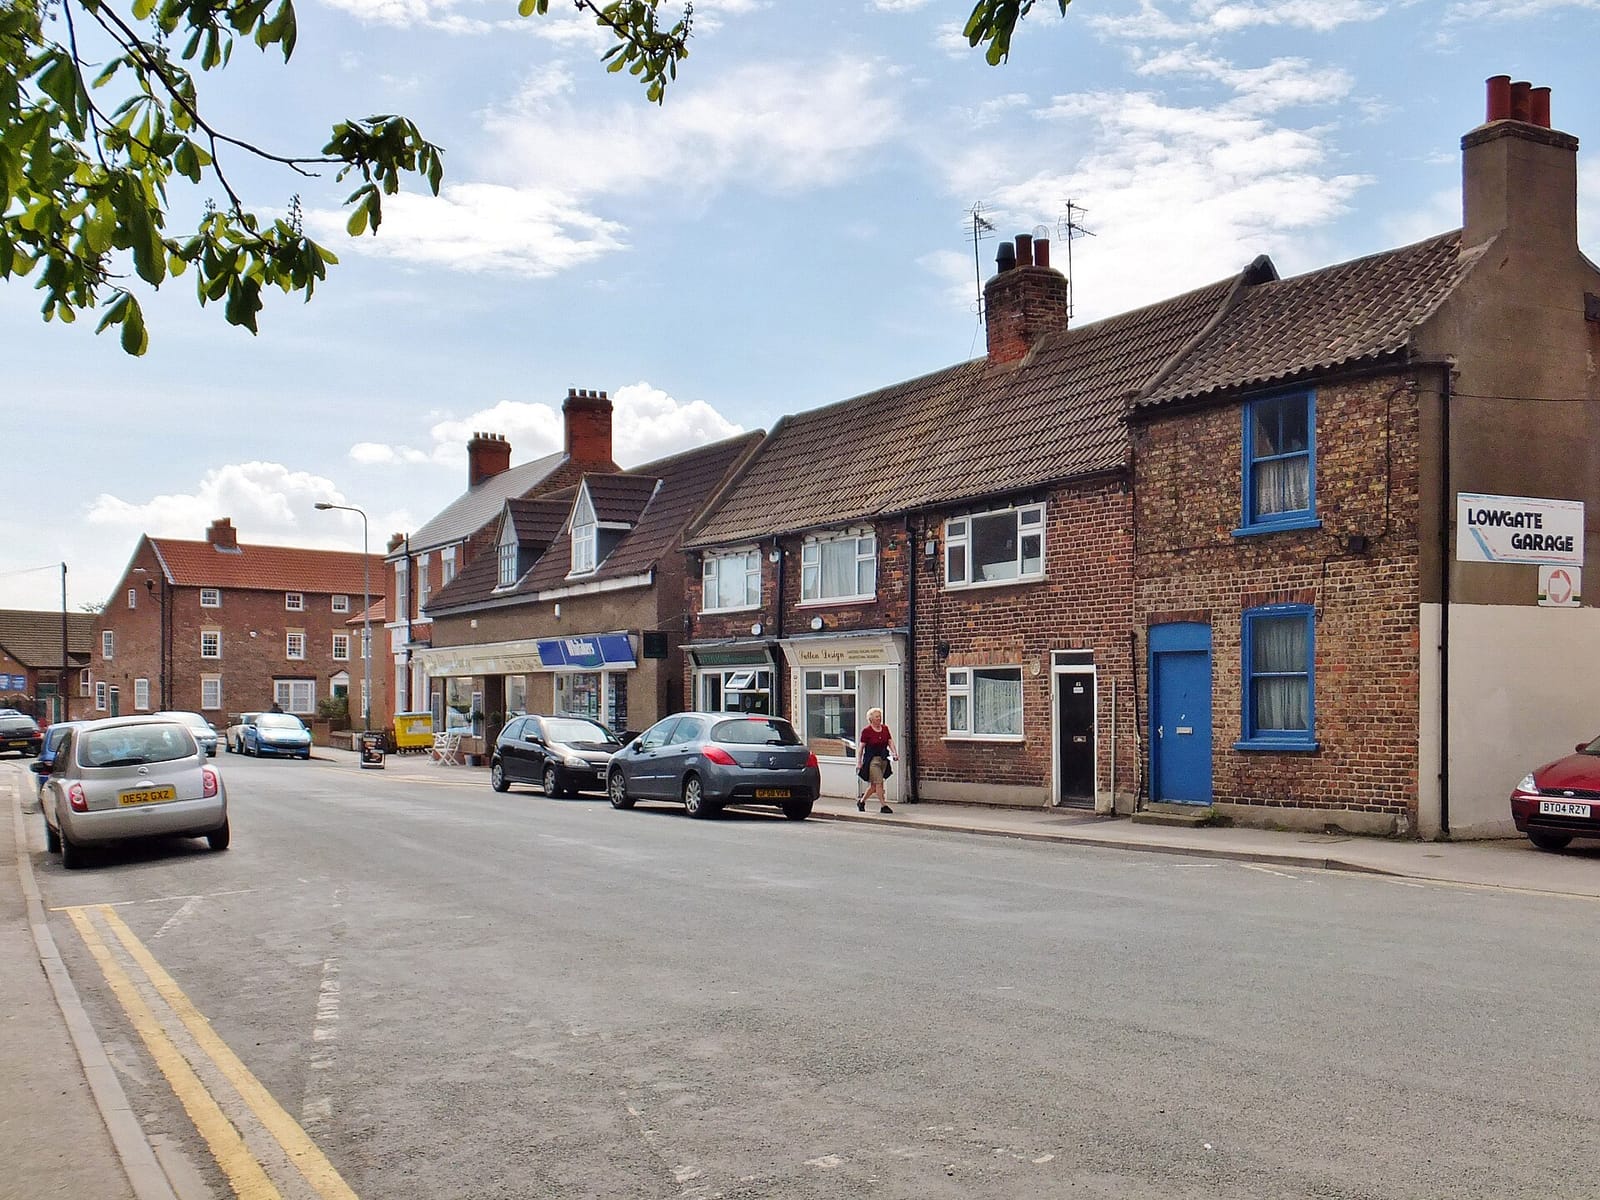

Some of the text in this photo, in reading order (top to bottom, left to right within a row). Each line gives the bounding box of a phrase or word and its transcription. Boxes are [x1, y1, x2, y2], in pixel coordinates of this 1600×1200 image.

[1468, 508, 1543, 529] LOWGATE
[1511, 533, 1574, 552] GARAGE
[150, 790, 169, 801] GXZ
[1543, 802, 1587, 815] BT04 RZY
